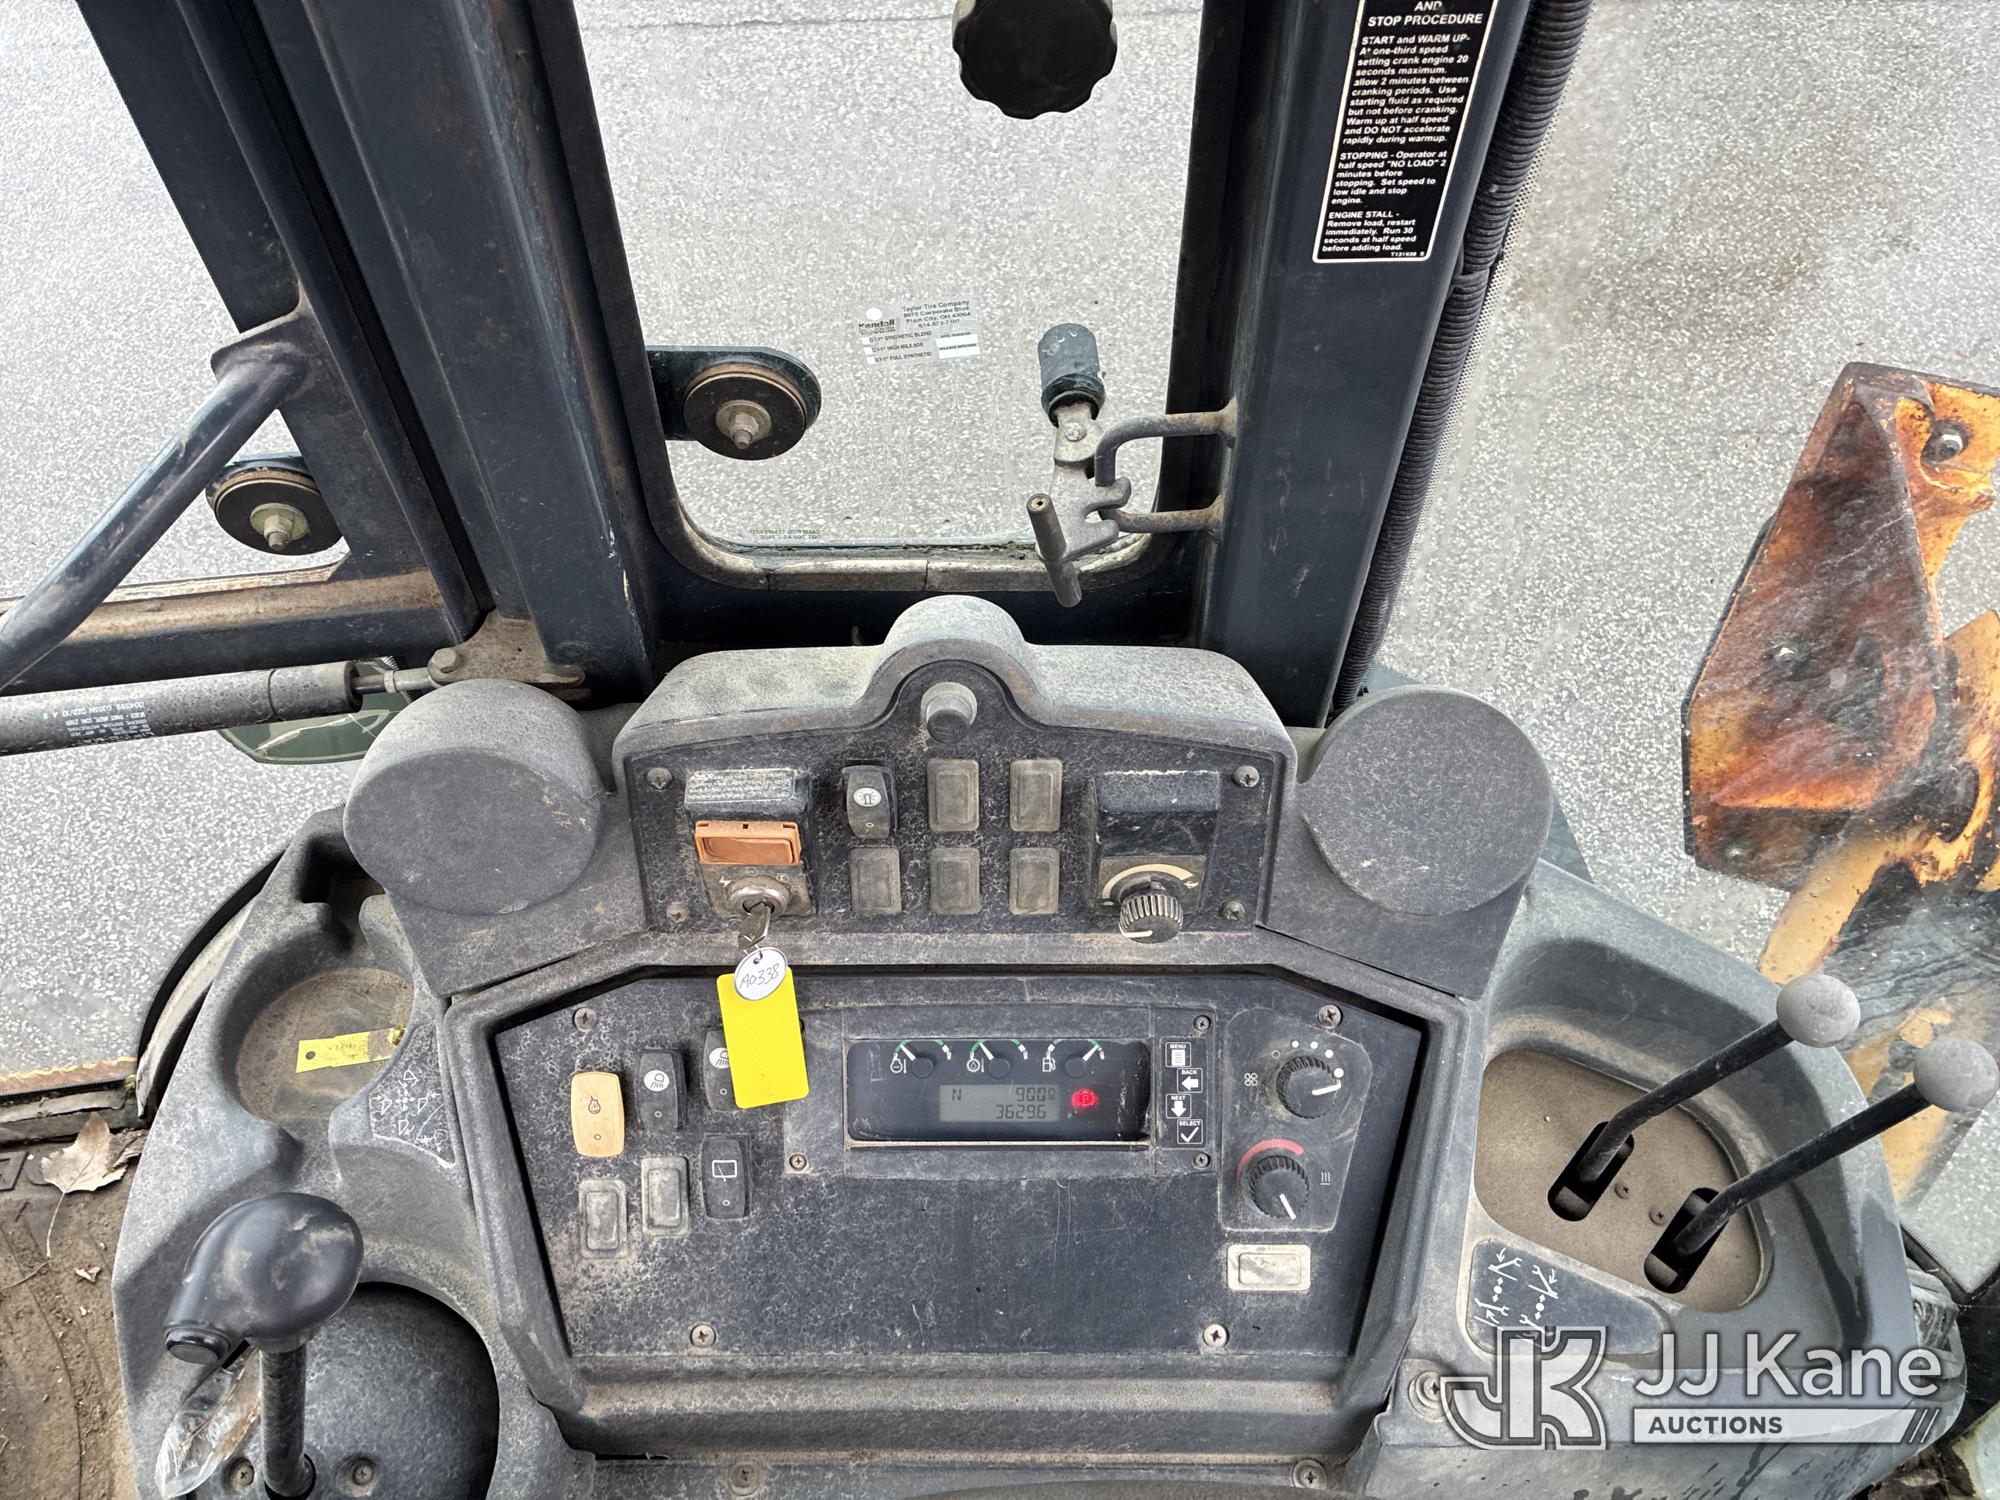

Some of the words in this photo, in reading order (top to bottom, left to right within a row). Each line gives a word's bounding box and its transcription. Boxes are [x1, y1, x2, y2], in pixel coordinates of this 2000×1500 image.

[1414, 1, 1442, 11] AND
[1368, 15, 1402, 27] STOP
[1404, 13, 1484, 26] PROCEDURE
[1361, 35, 1395, 46] START
[1396, 35, 1416, 44] and
[1418, 34, 1451, 44] WARM
[1372, 46, 1417, 55] one-third
[1419, 45, 1449, 55] speed
[1357, 57, 1391, 67] setting
[1392, 56, 1420, 65] crank
[1421, 55, 1455, 65] engine
[1456, 54, 1469, 64] 20
[1355, 67, 1396, 77] seconds
[1353, 78, 1379, 87] allow
[1380, 77, 1387, 86] 2
[1388, 77, 1427, 85] minutes
[1429, 76, 1469, 84] between
[1351, 87, 1393, 97] cranking
[1394, 86, 1433, 96] periods.
[1438, 86, 1457, 94] Use
[1350, 97, 1386, 107] starting
[1388, 96, 1410, 105] fluid
[1424, 95, 1465, 105] required
[1348, 108, 1364, 116] but
[1383, 106, 1413, 115] before
[1415, 105, 1458, 114] cranking.
[1346, 117, 1373, 126] Warm
[1375, 118, 1388, 126] up
[1400, 115, 1420, 124] half
[1420, 115, 1449, 125] speed
[1344, 127, 1363, 135] and
[1364, 126, 1379, 135] DO
[1380, 125, 1402, 134] NOT
[1403, 125, 1451, 133] accelerate
[1342, 136, 1375, 145] rapidly
[1376, 135, 1407, 144] during
[1408, 135, 1447, 143] warmup.
[1340, 151, 1389, 161] STOPPING
[1395, 151, 1437, 160] Operator
[1437, 150, 1448, 158] at
[1338, 161, 1356, 169] half
[1357, 161, 1385, 170] speed
[1440, 159, 1447, 167] 2
[1374, 169, 1403, 177] before
[1335, 179, 1376, 188] stopping.
[1380, 178, 1396, 186] Set
[1397, 177, 1426, 187] speed
[1368, 187, 1386, 195] and
[1387, 187, 1408, 195] stop
[1331, 197, 1363, 206] engine.
[1328, 211, 1364, 219] ENGINE
[1365, 210, 1394, 219] STALL
[1327, 220, 1362, 228] Remove
[1363, 219, 1385, 227] load,
[1325, 228, 1378, 236] immediately.
[1383, 227, 1401, 235] Run
[1324, 236, 1360, 244] seconds
[1371, 235, 1390, 243] half
[1390, 235, 1417, 243] speed
[1351, 244, 1381, 252] adding
[1382, 243, 1403, 251] load.
[903, 305, 922, 313] Taylor
[938, 300, 970, 308] Company
[920, 309, 953, 317] Corporate
[858, 319, 895, 328] Kendall
[952, 1088, 962, 1101] N
